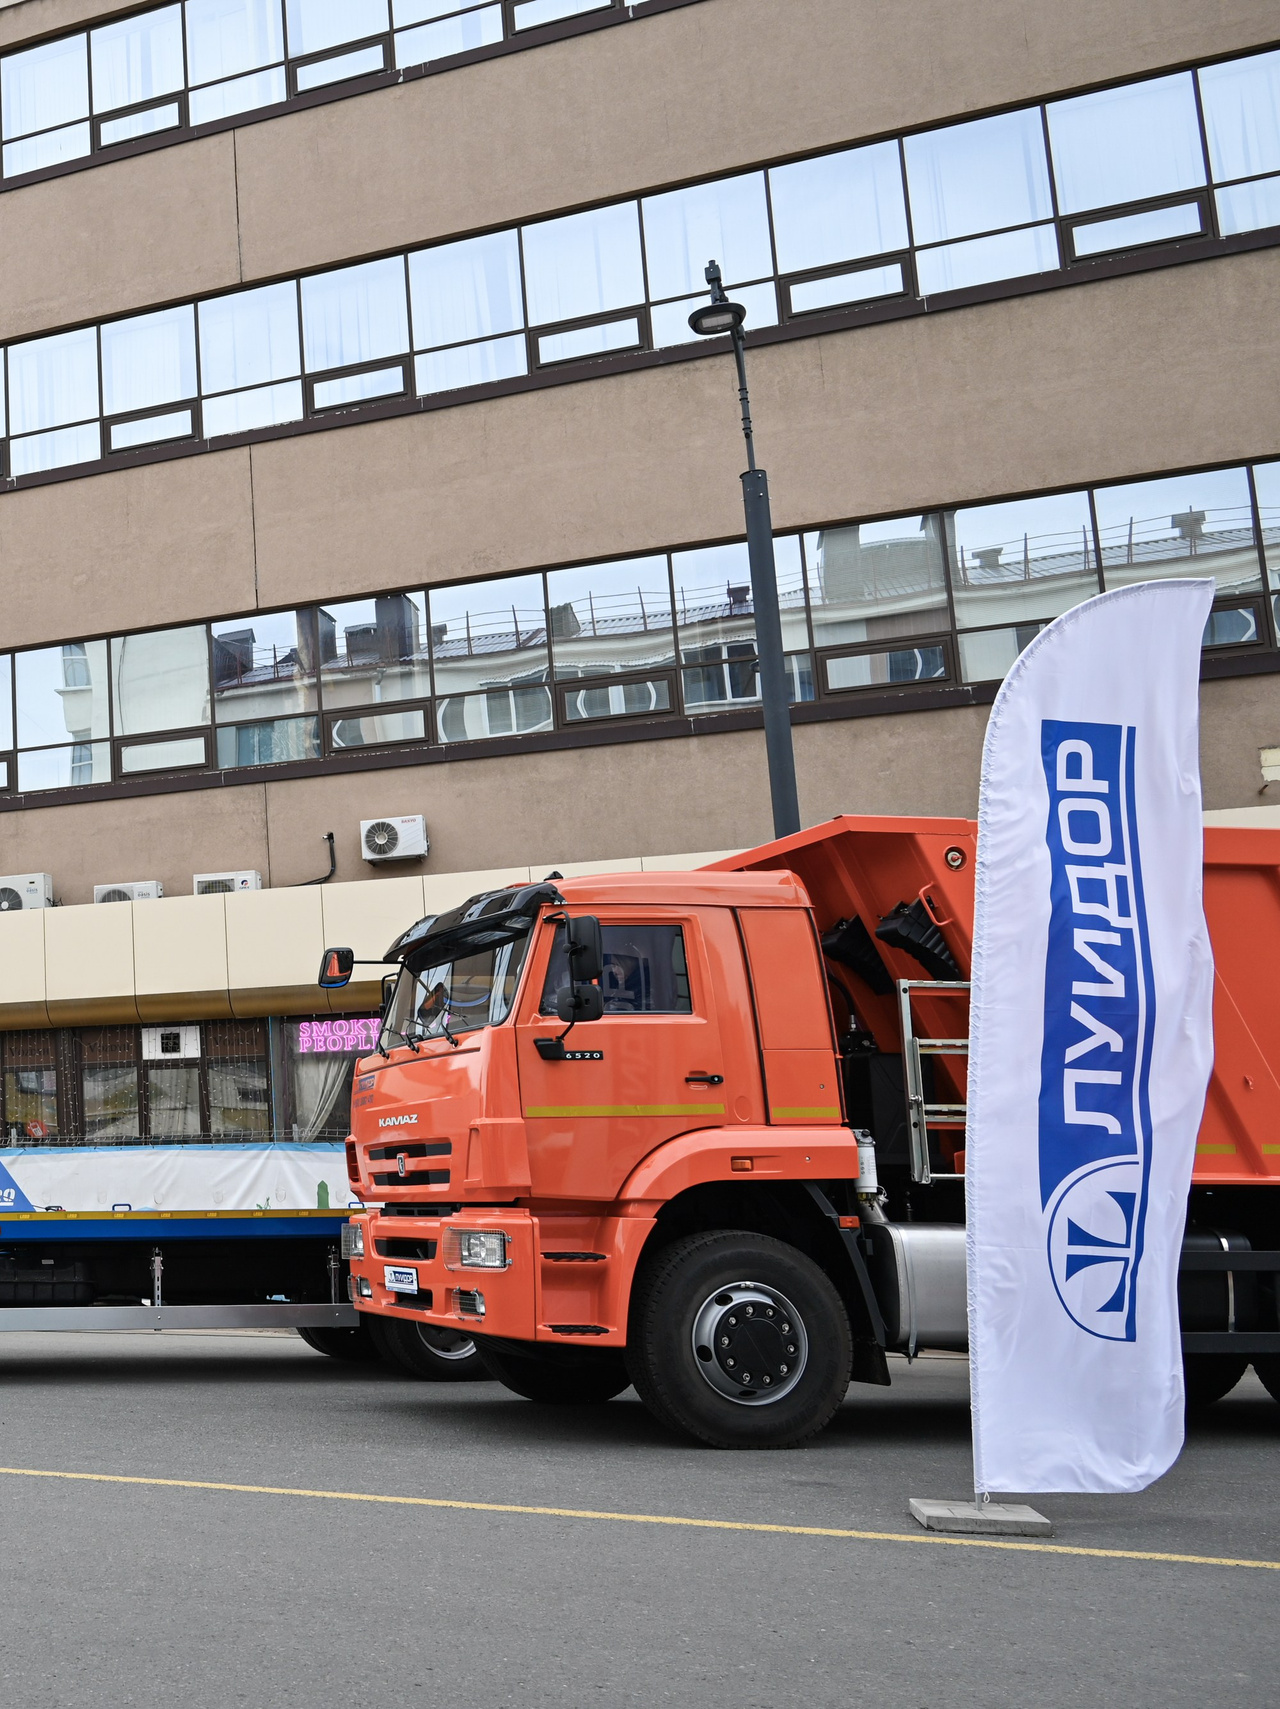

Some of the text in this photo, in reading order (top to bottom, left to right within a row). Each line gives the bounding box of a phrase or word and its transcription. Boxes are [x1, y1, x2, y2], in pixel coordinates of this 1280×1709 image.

[1056, 739, 1134, 1135] ЛУИДОР
[299, 1018, 382, 1037] SMOKY
[379, 1114, 418, 1127] KAMAZ
